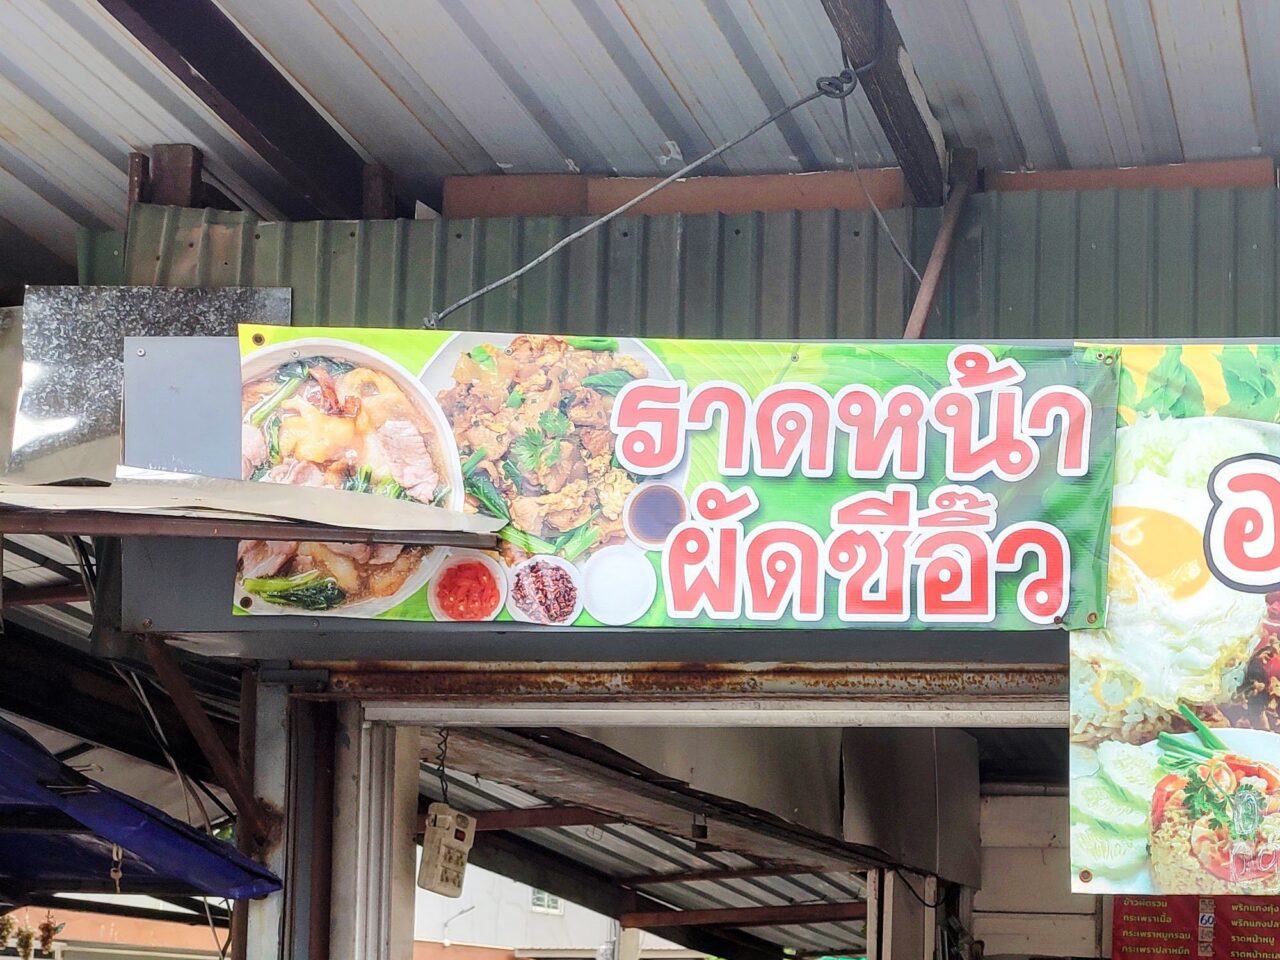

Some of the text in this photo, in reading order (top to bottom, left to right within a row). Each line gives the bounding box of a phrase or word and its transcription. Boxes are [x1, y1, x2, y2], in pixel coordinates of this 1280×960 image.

[614, 348, 1090, 479] ราดหน้า
[662, 486, 1070, 622] ผัดซีอิ๊ว
